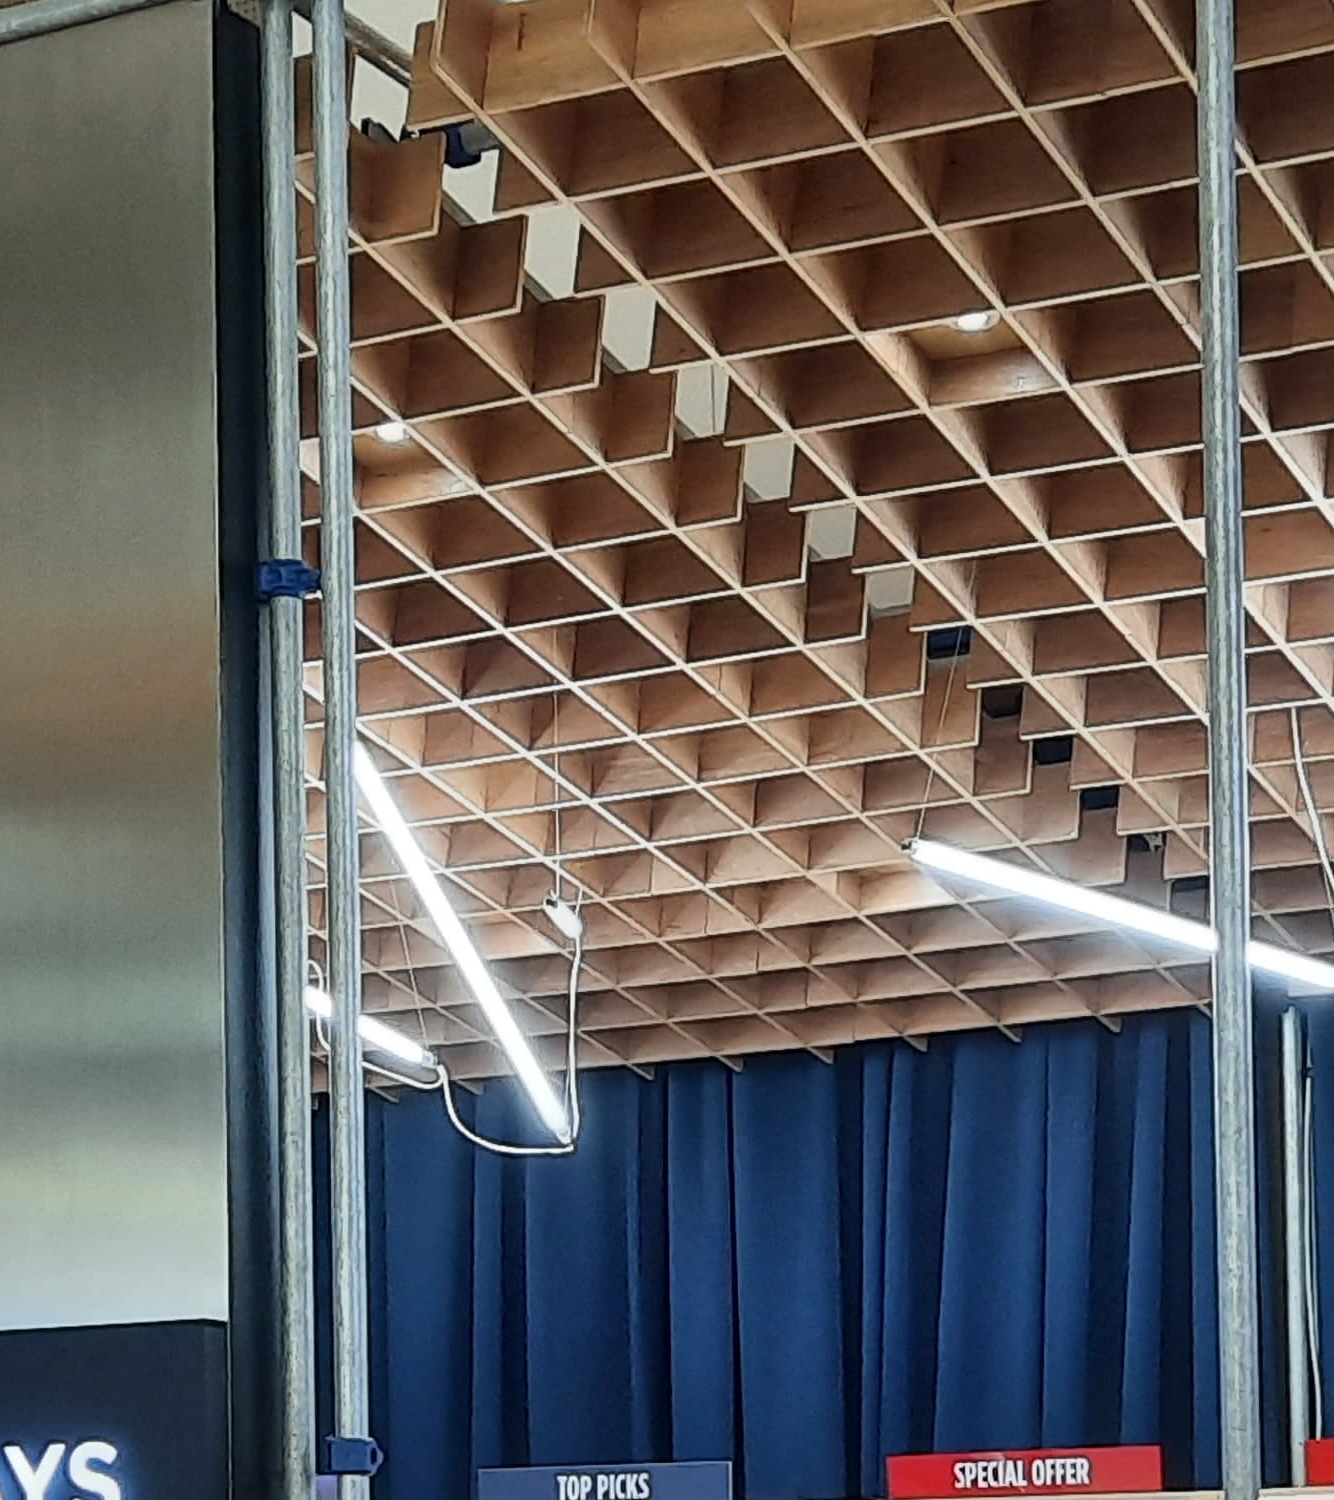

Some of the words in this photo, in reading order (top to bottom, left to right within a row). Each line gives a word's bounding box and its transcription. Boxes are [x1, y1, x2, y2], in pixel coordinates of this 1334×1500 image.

[557, 1475, 592, 1500] TOP
[597, 1472, 650, 1500] PICKS
[953, 1458, 1028, 1489] SPECIAL
[1031, 1457, 1090, 1486] OFFER
